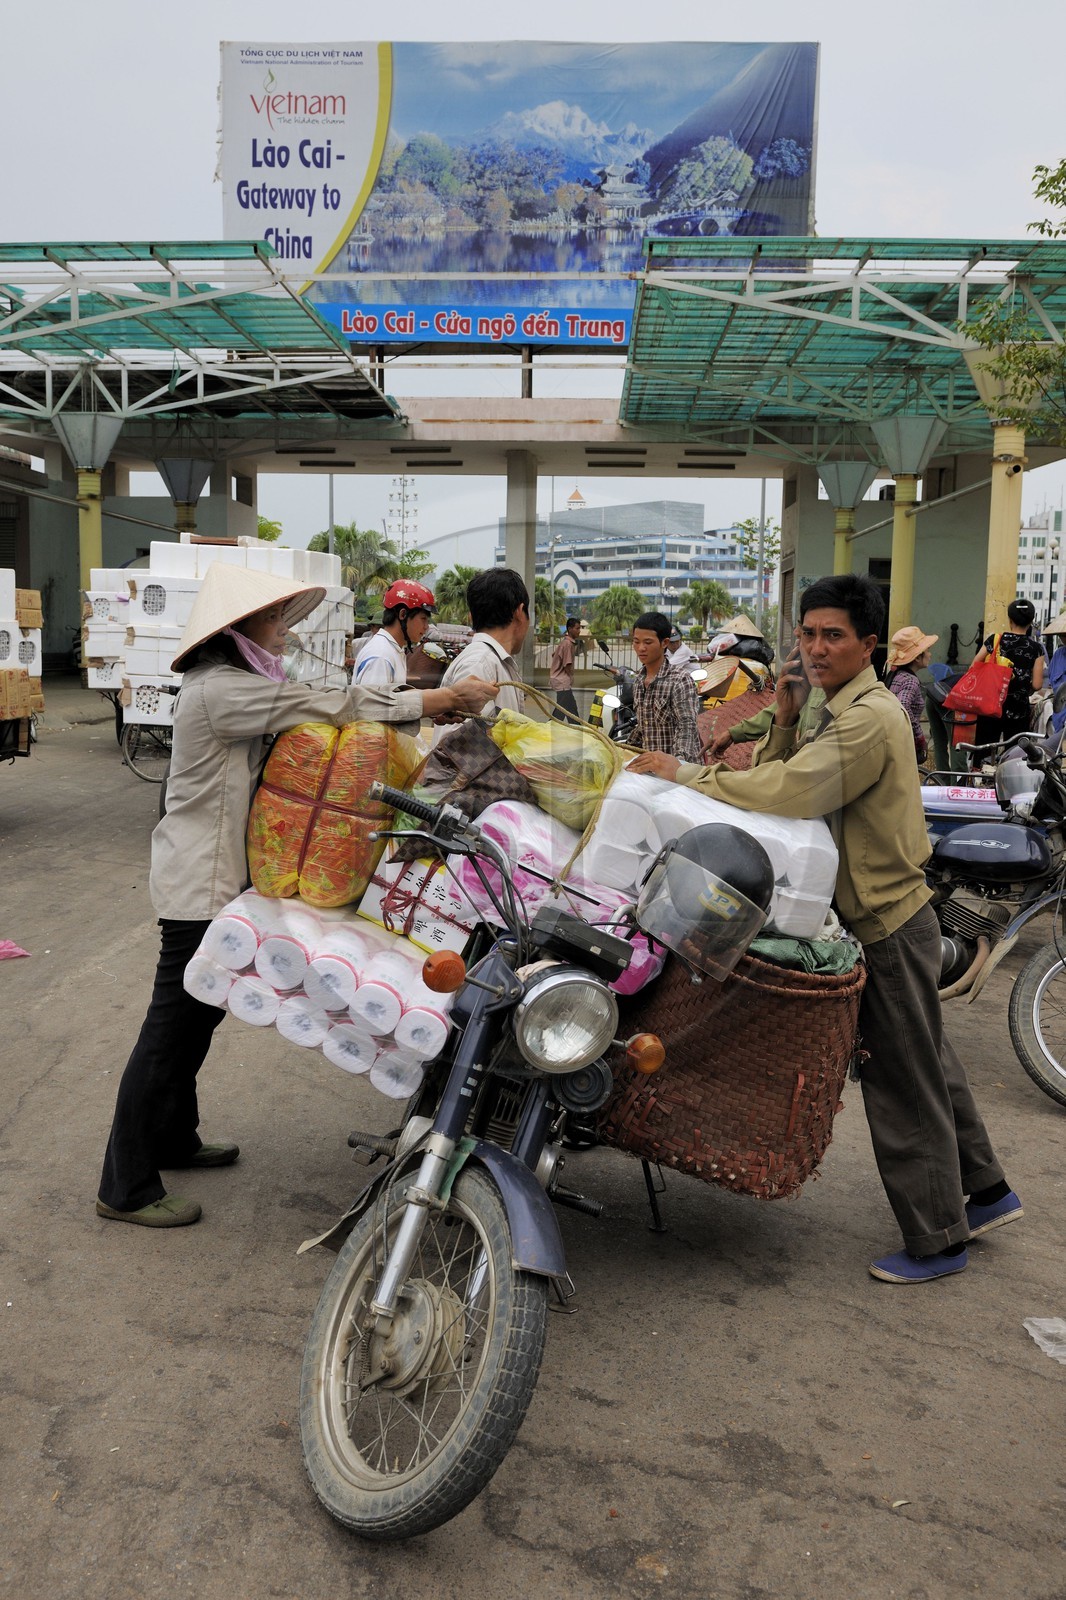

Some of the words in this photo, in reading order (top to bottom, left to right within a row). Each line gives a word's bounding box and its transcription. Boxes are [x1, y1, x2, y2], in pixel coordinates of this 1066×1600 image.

[240, 47, 264, 57] TỔNG
[266, 50, 283, 58] CỤC
[301, 50, 320, 59] LỊCH
[322, 49, 340, 58] VIỆT
[277, 116, 292, 124] The
[293, 116, 319, 125] hidden
[321, 117, 346, 125] charm
[252, 138, 290, 168] Lào
[236, 180, 316, 217] Gateway
[322, 183, 341, 210] to
[342, 310, 377, 333] Lào
[384, 311, 415, 334] Cai
[434, 310, 471, 335] Cửa
[478, 313, 515, 340] ngõ
[522, 310, 559, 337] đến
[566, 315, 625, 343] Trung
